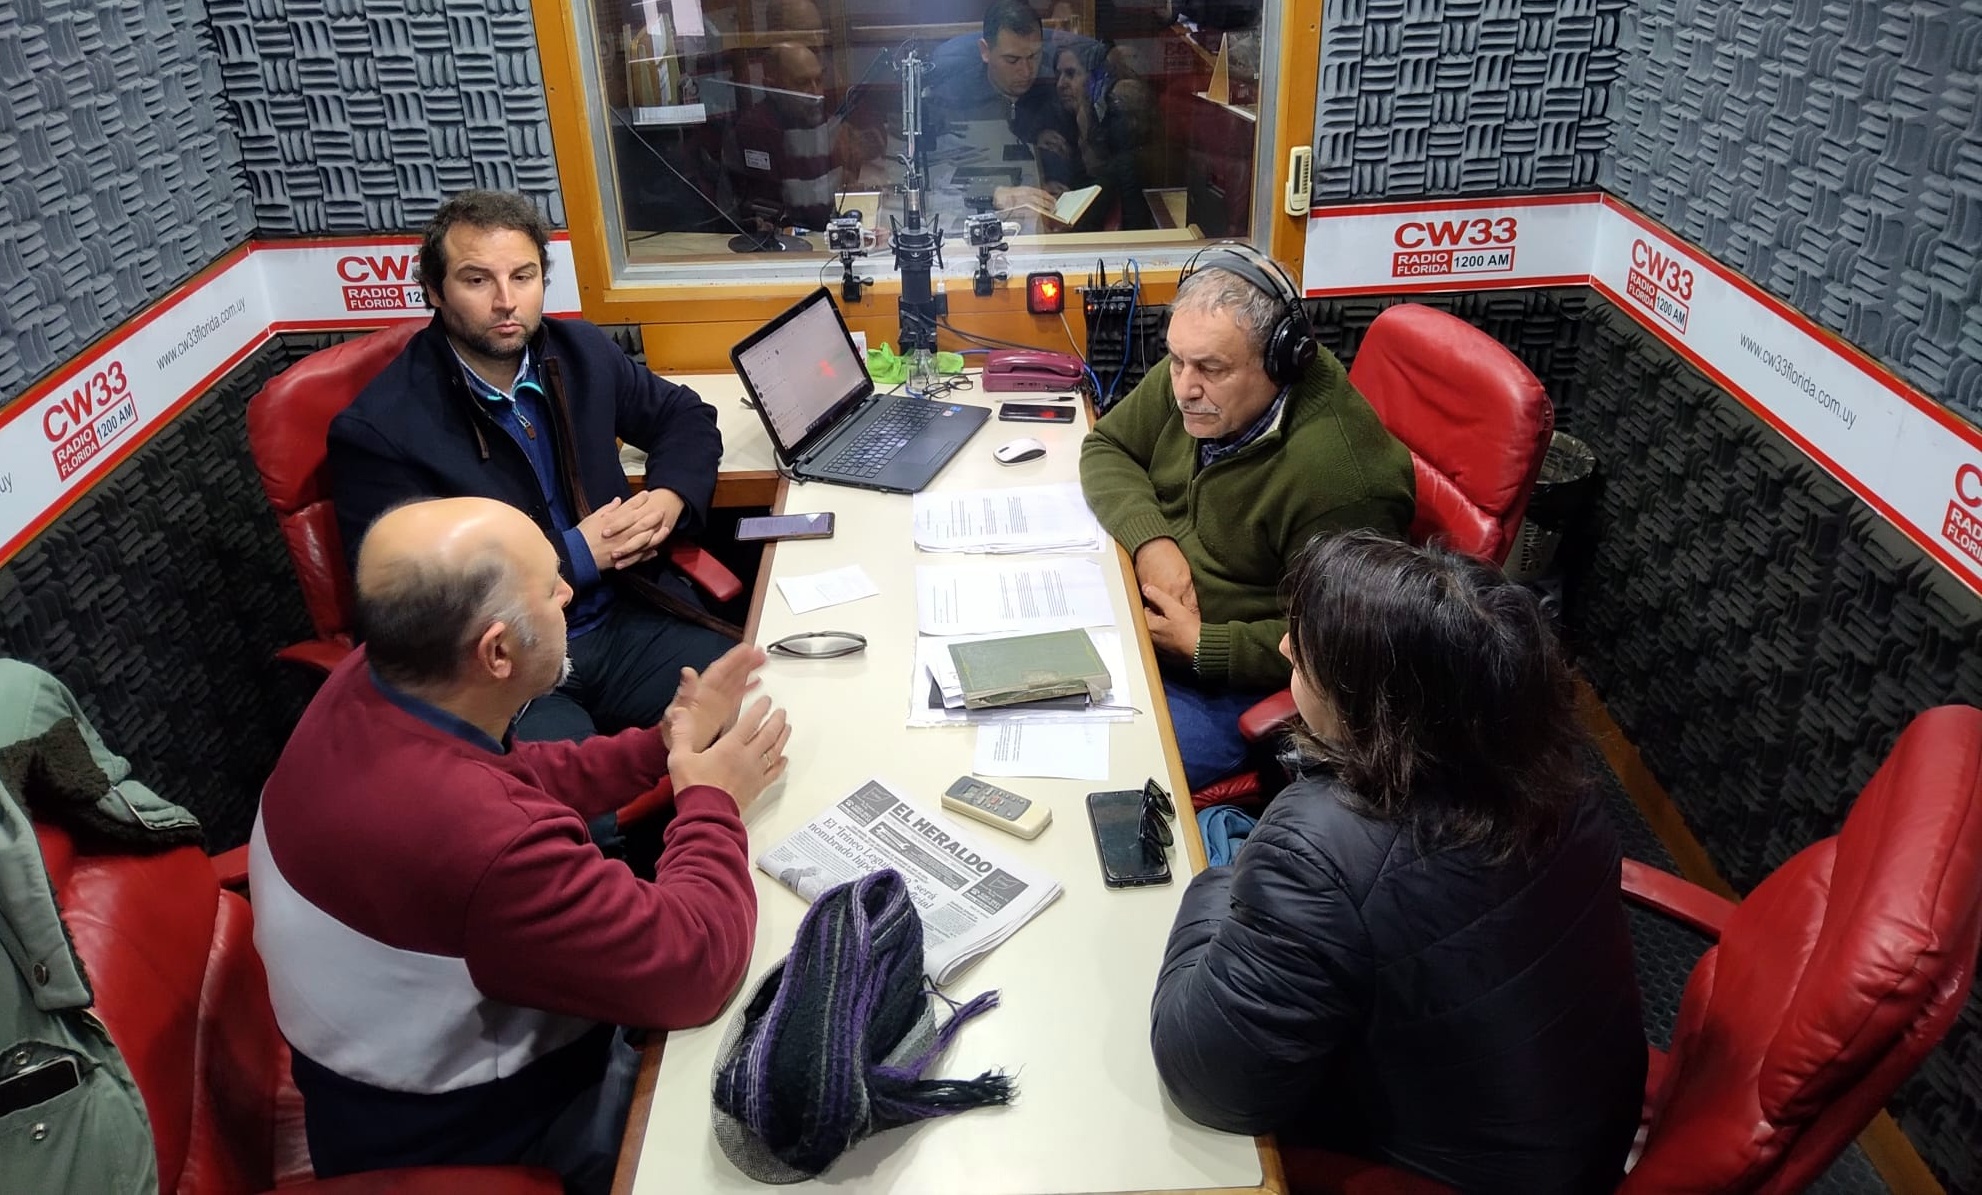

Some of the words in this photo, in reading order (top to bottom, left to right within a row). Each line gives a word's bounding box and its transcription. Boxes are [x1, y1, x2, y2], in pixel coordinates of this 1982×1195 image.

[1394, 216, 1517, 249] CW33
[336, 254, 421, 283] CW
[1397, 264, 1448, 275] FLORIDA
[1398, 253, 1448, 264] RADIO
[1454, 255, 1484, 268] 1200
[1487, 254, 1509, 266] AM
[1632, 239, 1694, 301] CW33
[347, 287, 399, 299] RADIO
[406, 291, 422, 303] 12
[1628, 284, 1654, 309] FLORIDA
[1630, 272, 1655, 296] RADIO
[350, 299, 403, 309] FLORIDA
[1657, 296, 1673, 317] 1200
[1672, 308, 1686, 327] AM
[156, 295, 247, 371] www.cw33florida.com.uy
[1740, 332, 1857, 430] www.cw33florida.com.uy
[43, 361, 127, 442] CW33
[96, 415, 118, 441] 1200
[119, 402, 133, 425] AM
[56, 428, 93, 464] RADIO
[61, 441, 98, 477] FLORIDA
[1951, 508, 1982, 541] RAD
[823, 817, 837, 829] El
[891, 802, 915, 823] EL
[912, 817, 993, 873] HERALDO
[808, 822, 854, 859] nombrado
